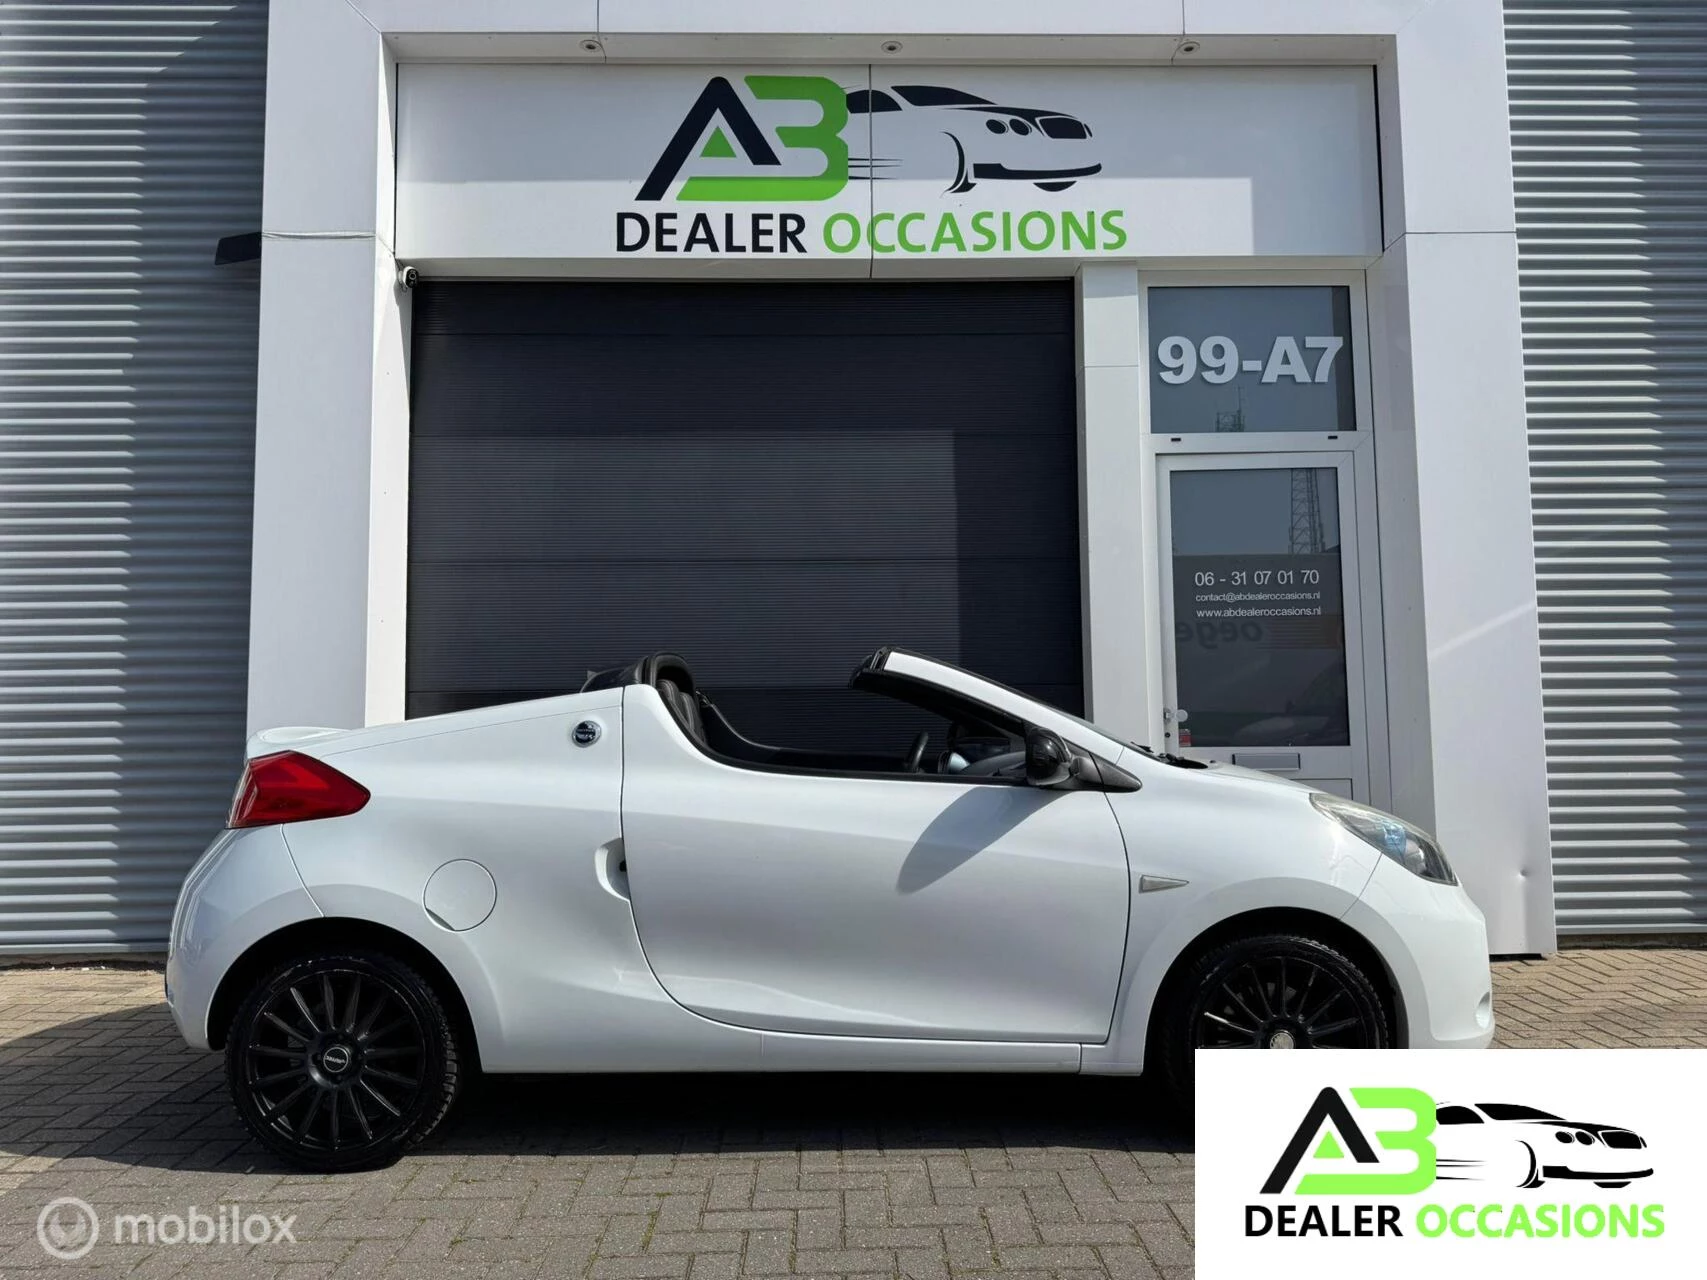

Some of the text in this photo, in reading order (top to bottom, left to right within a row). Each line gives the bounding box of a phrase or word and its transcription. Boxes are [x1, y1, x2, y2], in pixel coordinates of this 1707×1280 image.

[635, 75, 849, 201] AB
[616, 209, 1128, 253] DEALER OCCASIONS
[1157, 335, 1344, 384] 99-A7
[1194, 571, 1214, 586] 06
[1231, 571, 1247, 586] 31
[1254, 570, 1272, 585] 07
[1277, 570, 1293, 585] 01
[1301, 569, 1320, 585] 70
[1195, 591, 1321, 603] contact@abdealeroccasions.nl
[1196, 606, 1322, 617] www.abdealeroccasions.nl
